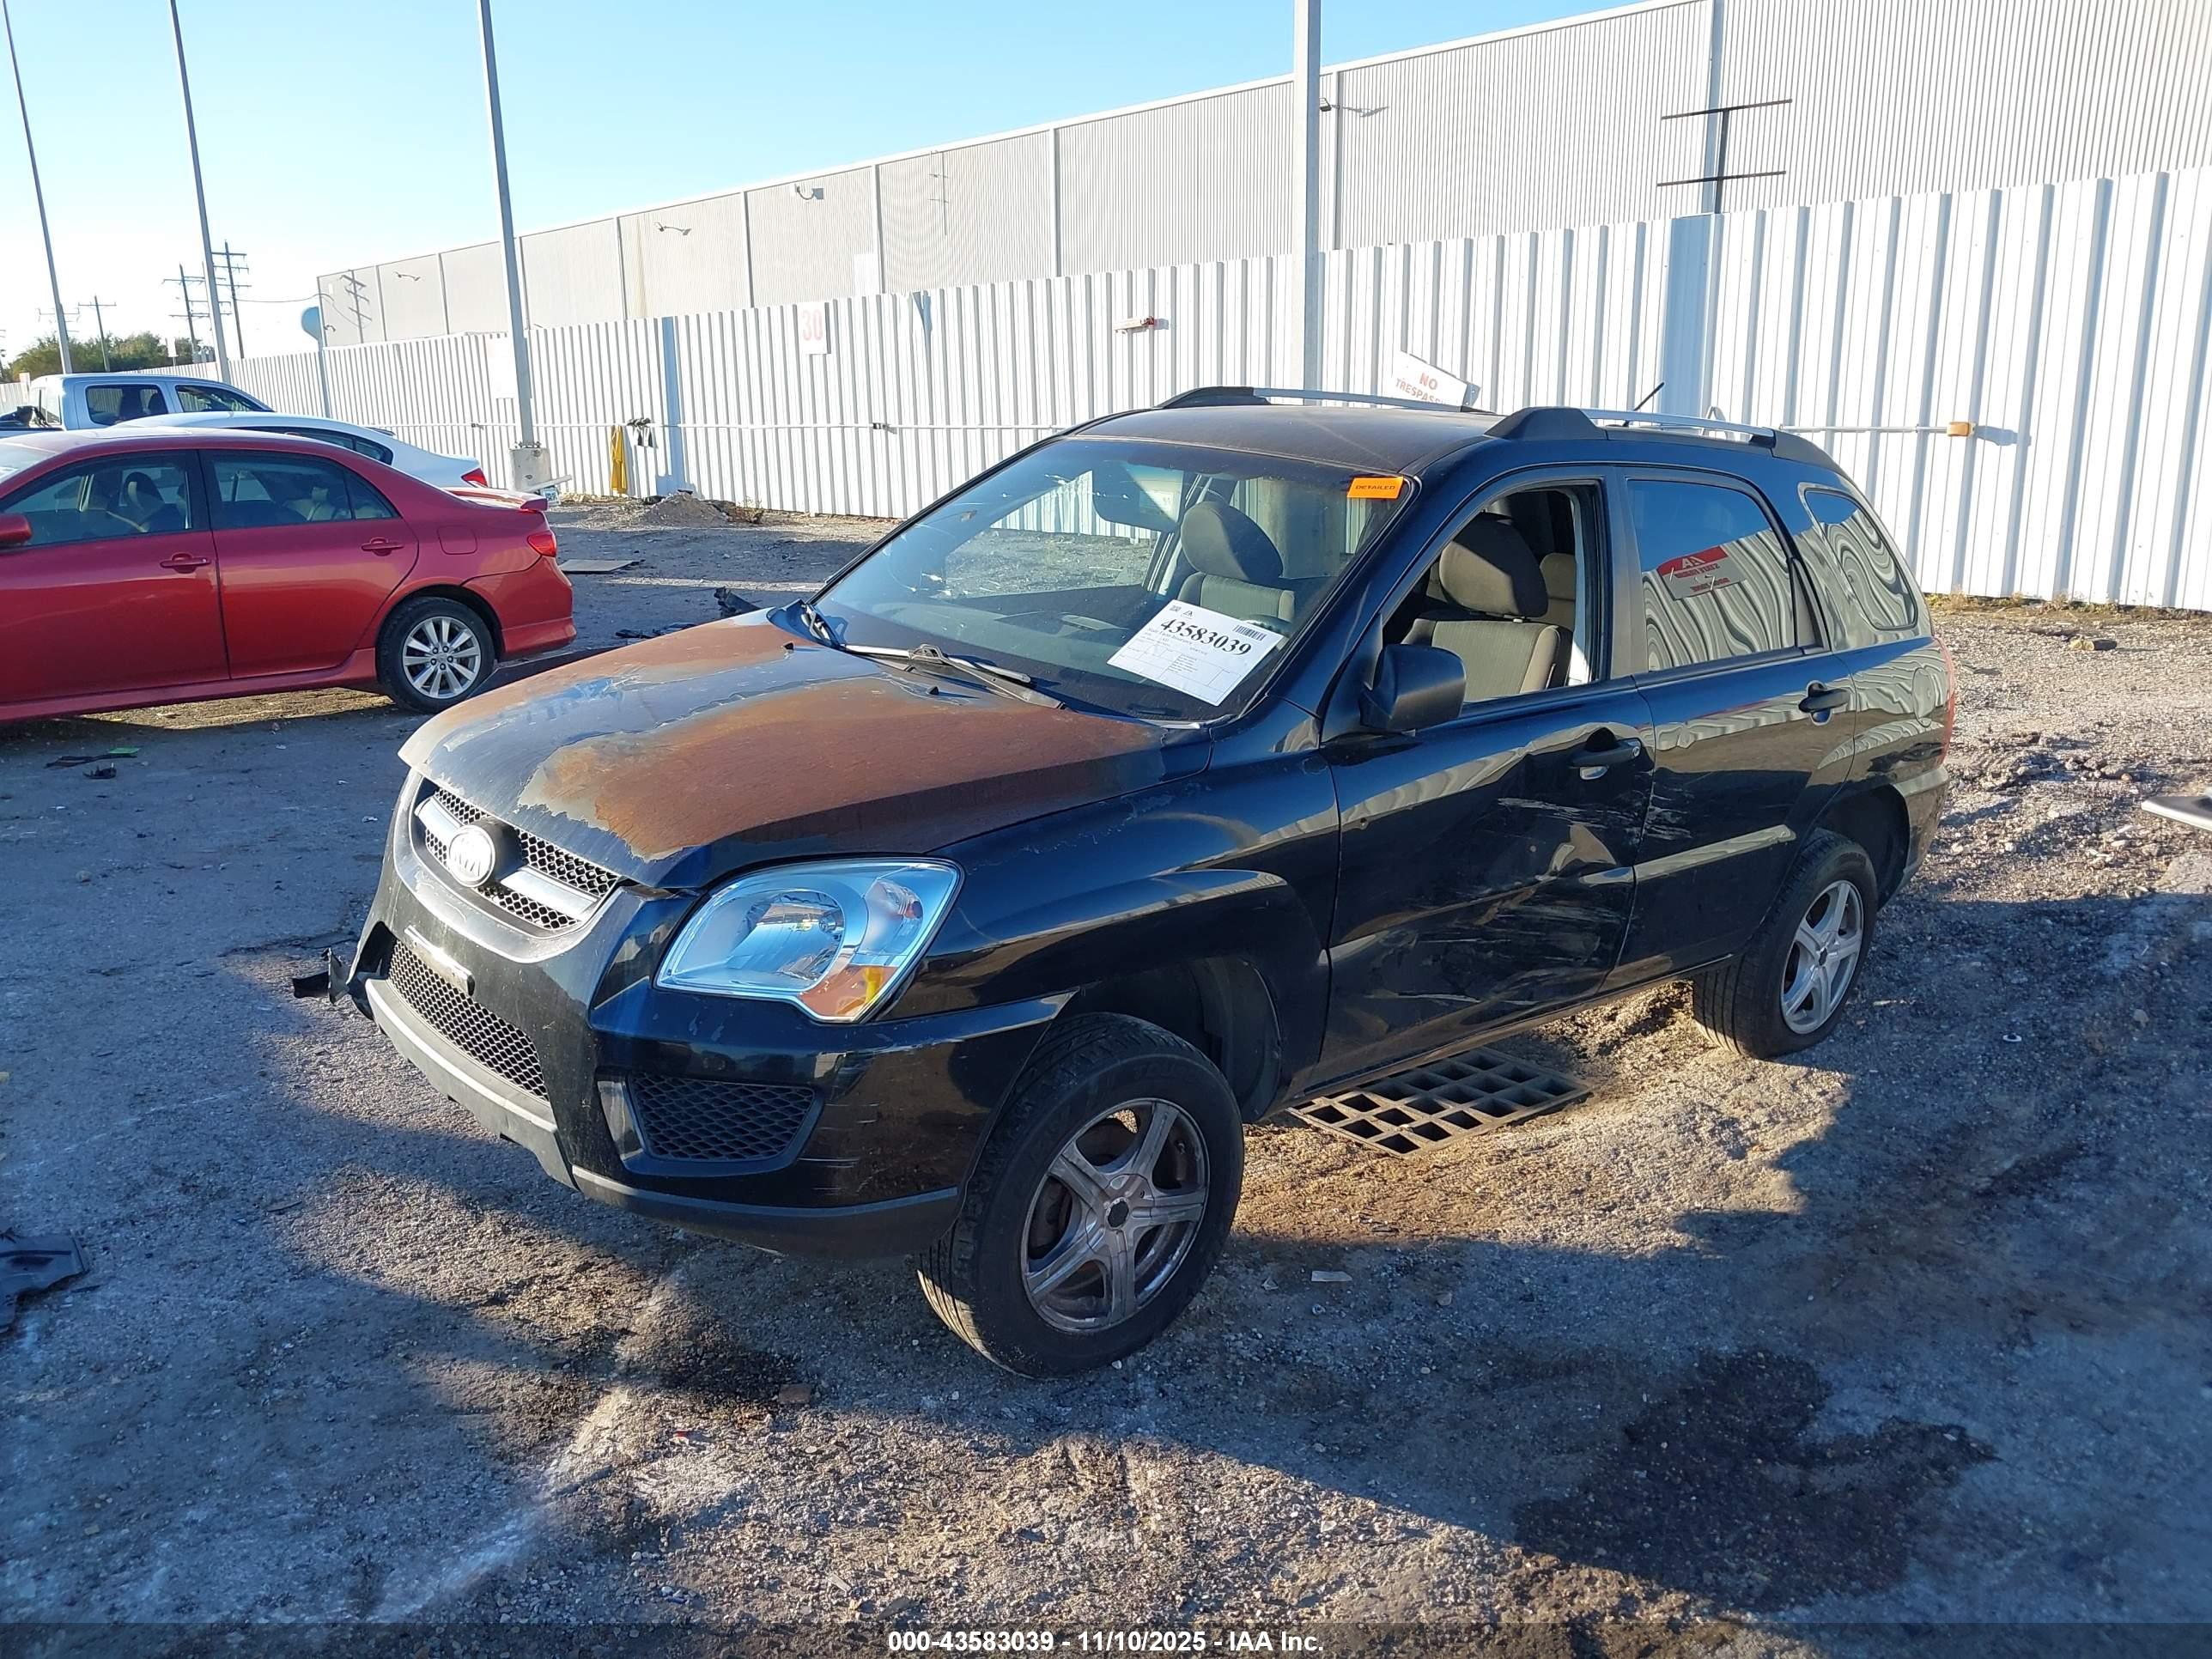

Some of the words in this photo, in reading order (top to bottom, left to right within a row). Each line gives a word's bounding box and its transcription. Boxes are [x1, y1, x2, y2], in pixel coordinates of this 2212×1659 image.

[801, 308, 823, 341] 30
[1395, 377, 1443, 404] TRESPAS
[1419, 372, 1438, 391] NO
[1159, 617, 1252, 656] 43583039
